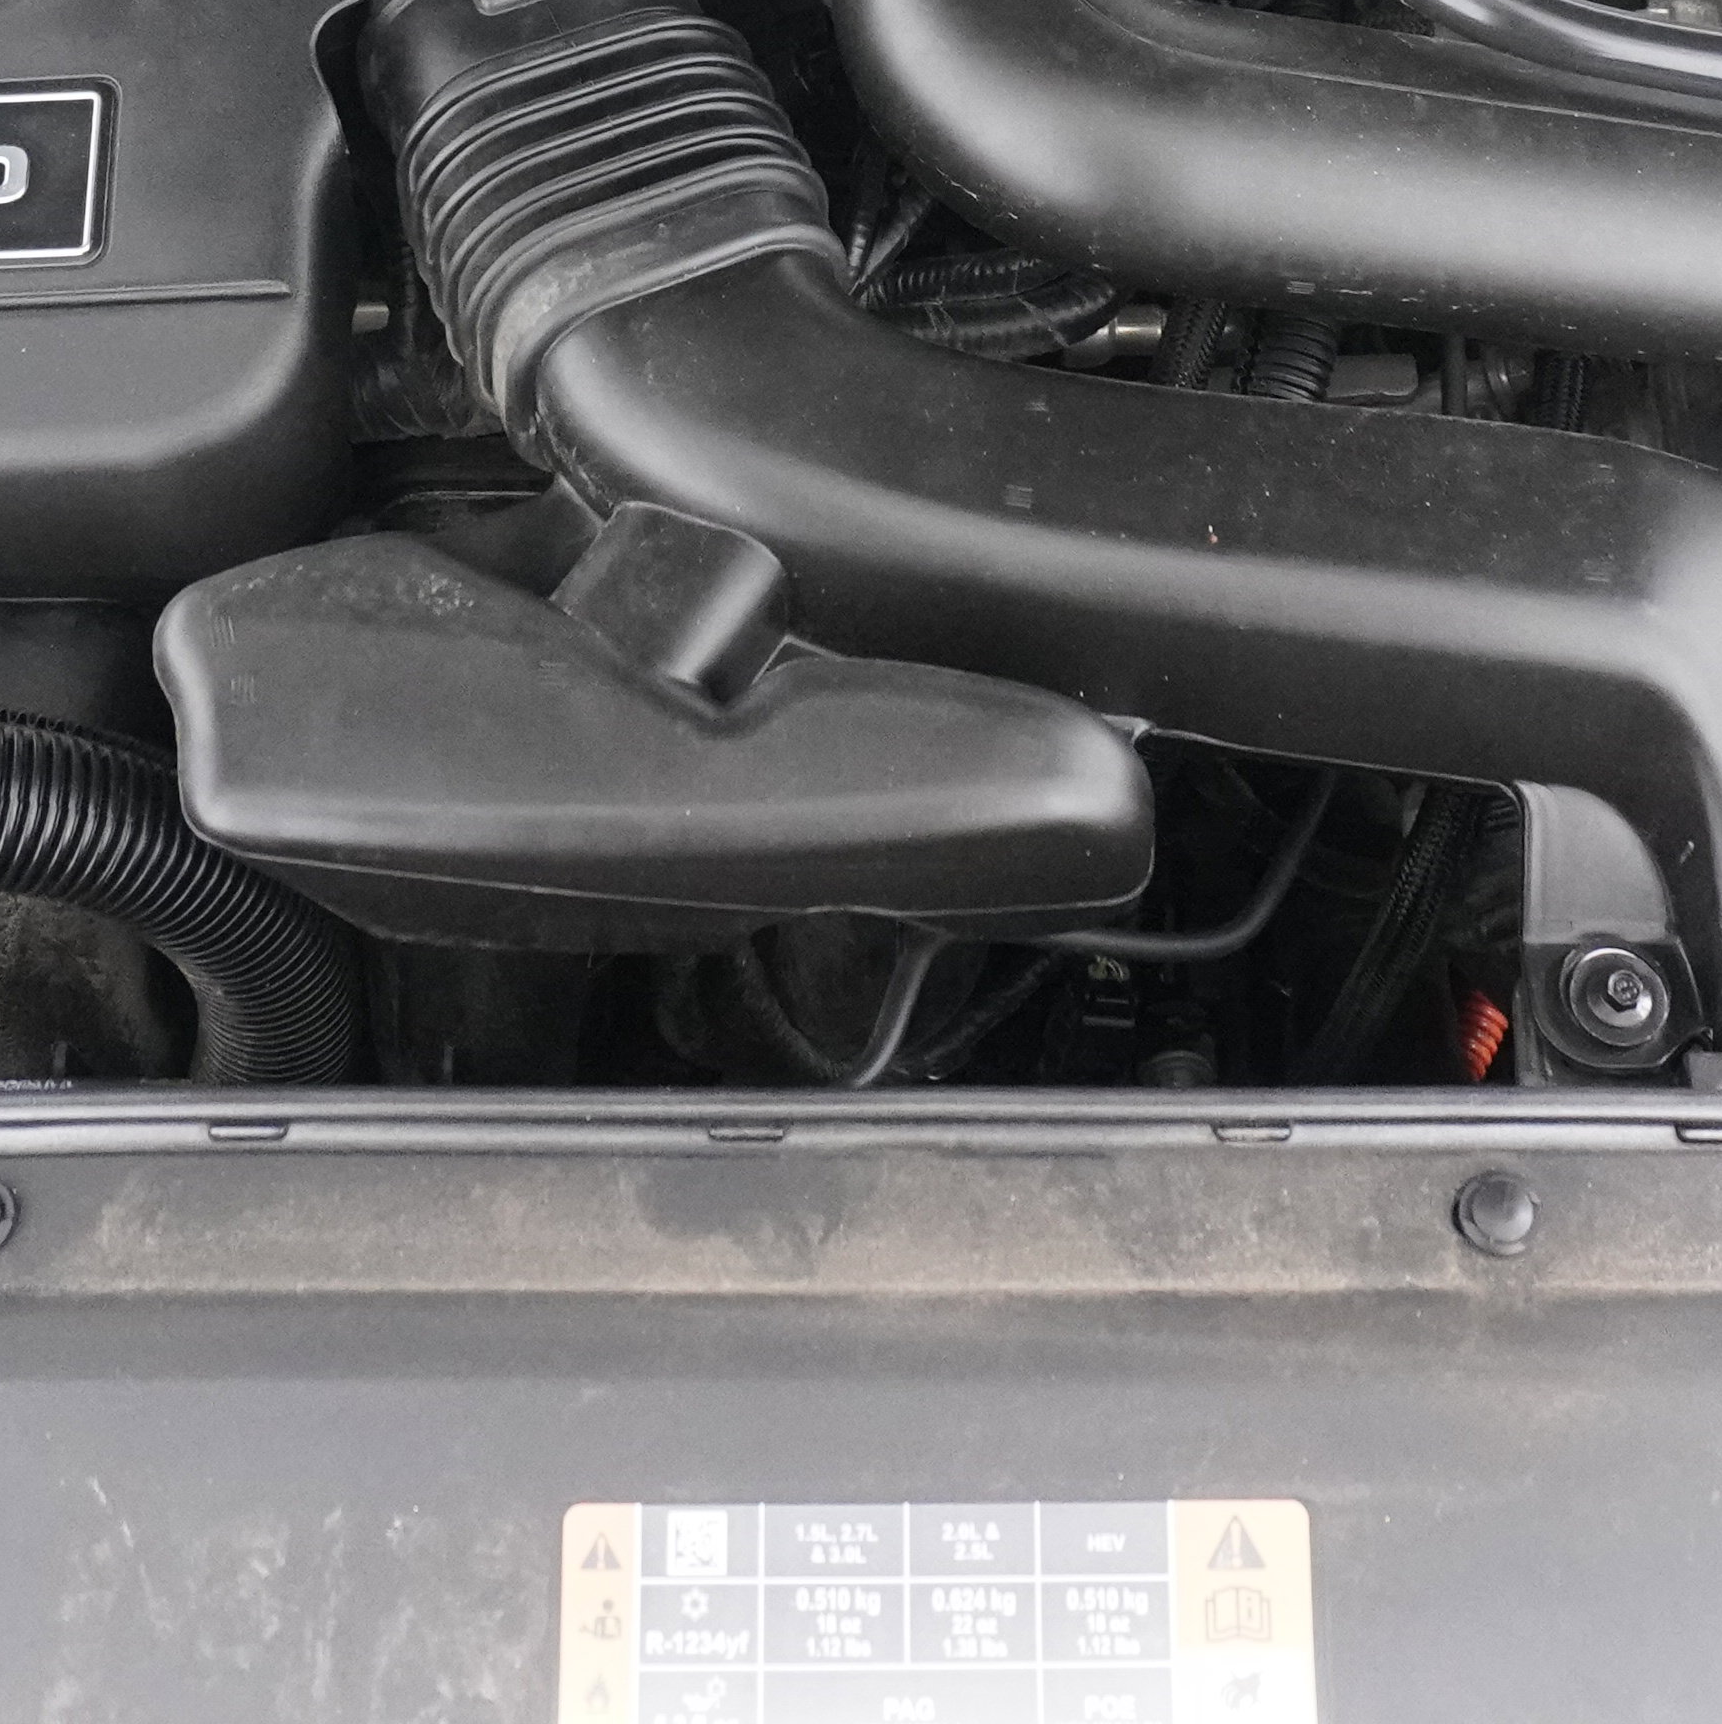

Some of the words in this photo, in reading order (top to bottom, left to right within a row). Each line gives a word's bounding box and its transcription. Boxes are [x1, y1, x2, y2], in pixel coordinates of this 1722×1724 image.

[1086, 1533, 1126, 1552] HEV
[795, 1586, 851, 1612] 0.510
[854, 1586, 882, 1617] kg
[990, 1586, 1017, 1616] kg
[1065, 1586, 1119, 1611] 0.510
[1122, 1586, 1149, 1616] kg
[645, 1629, 751, 1660] R-1234yf
[882, 1696, 936, 1722] PAG
[1084, 1694, 1137, 1721] POE
